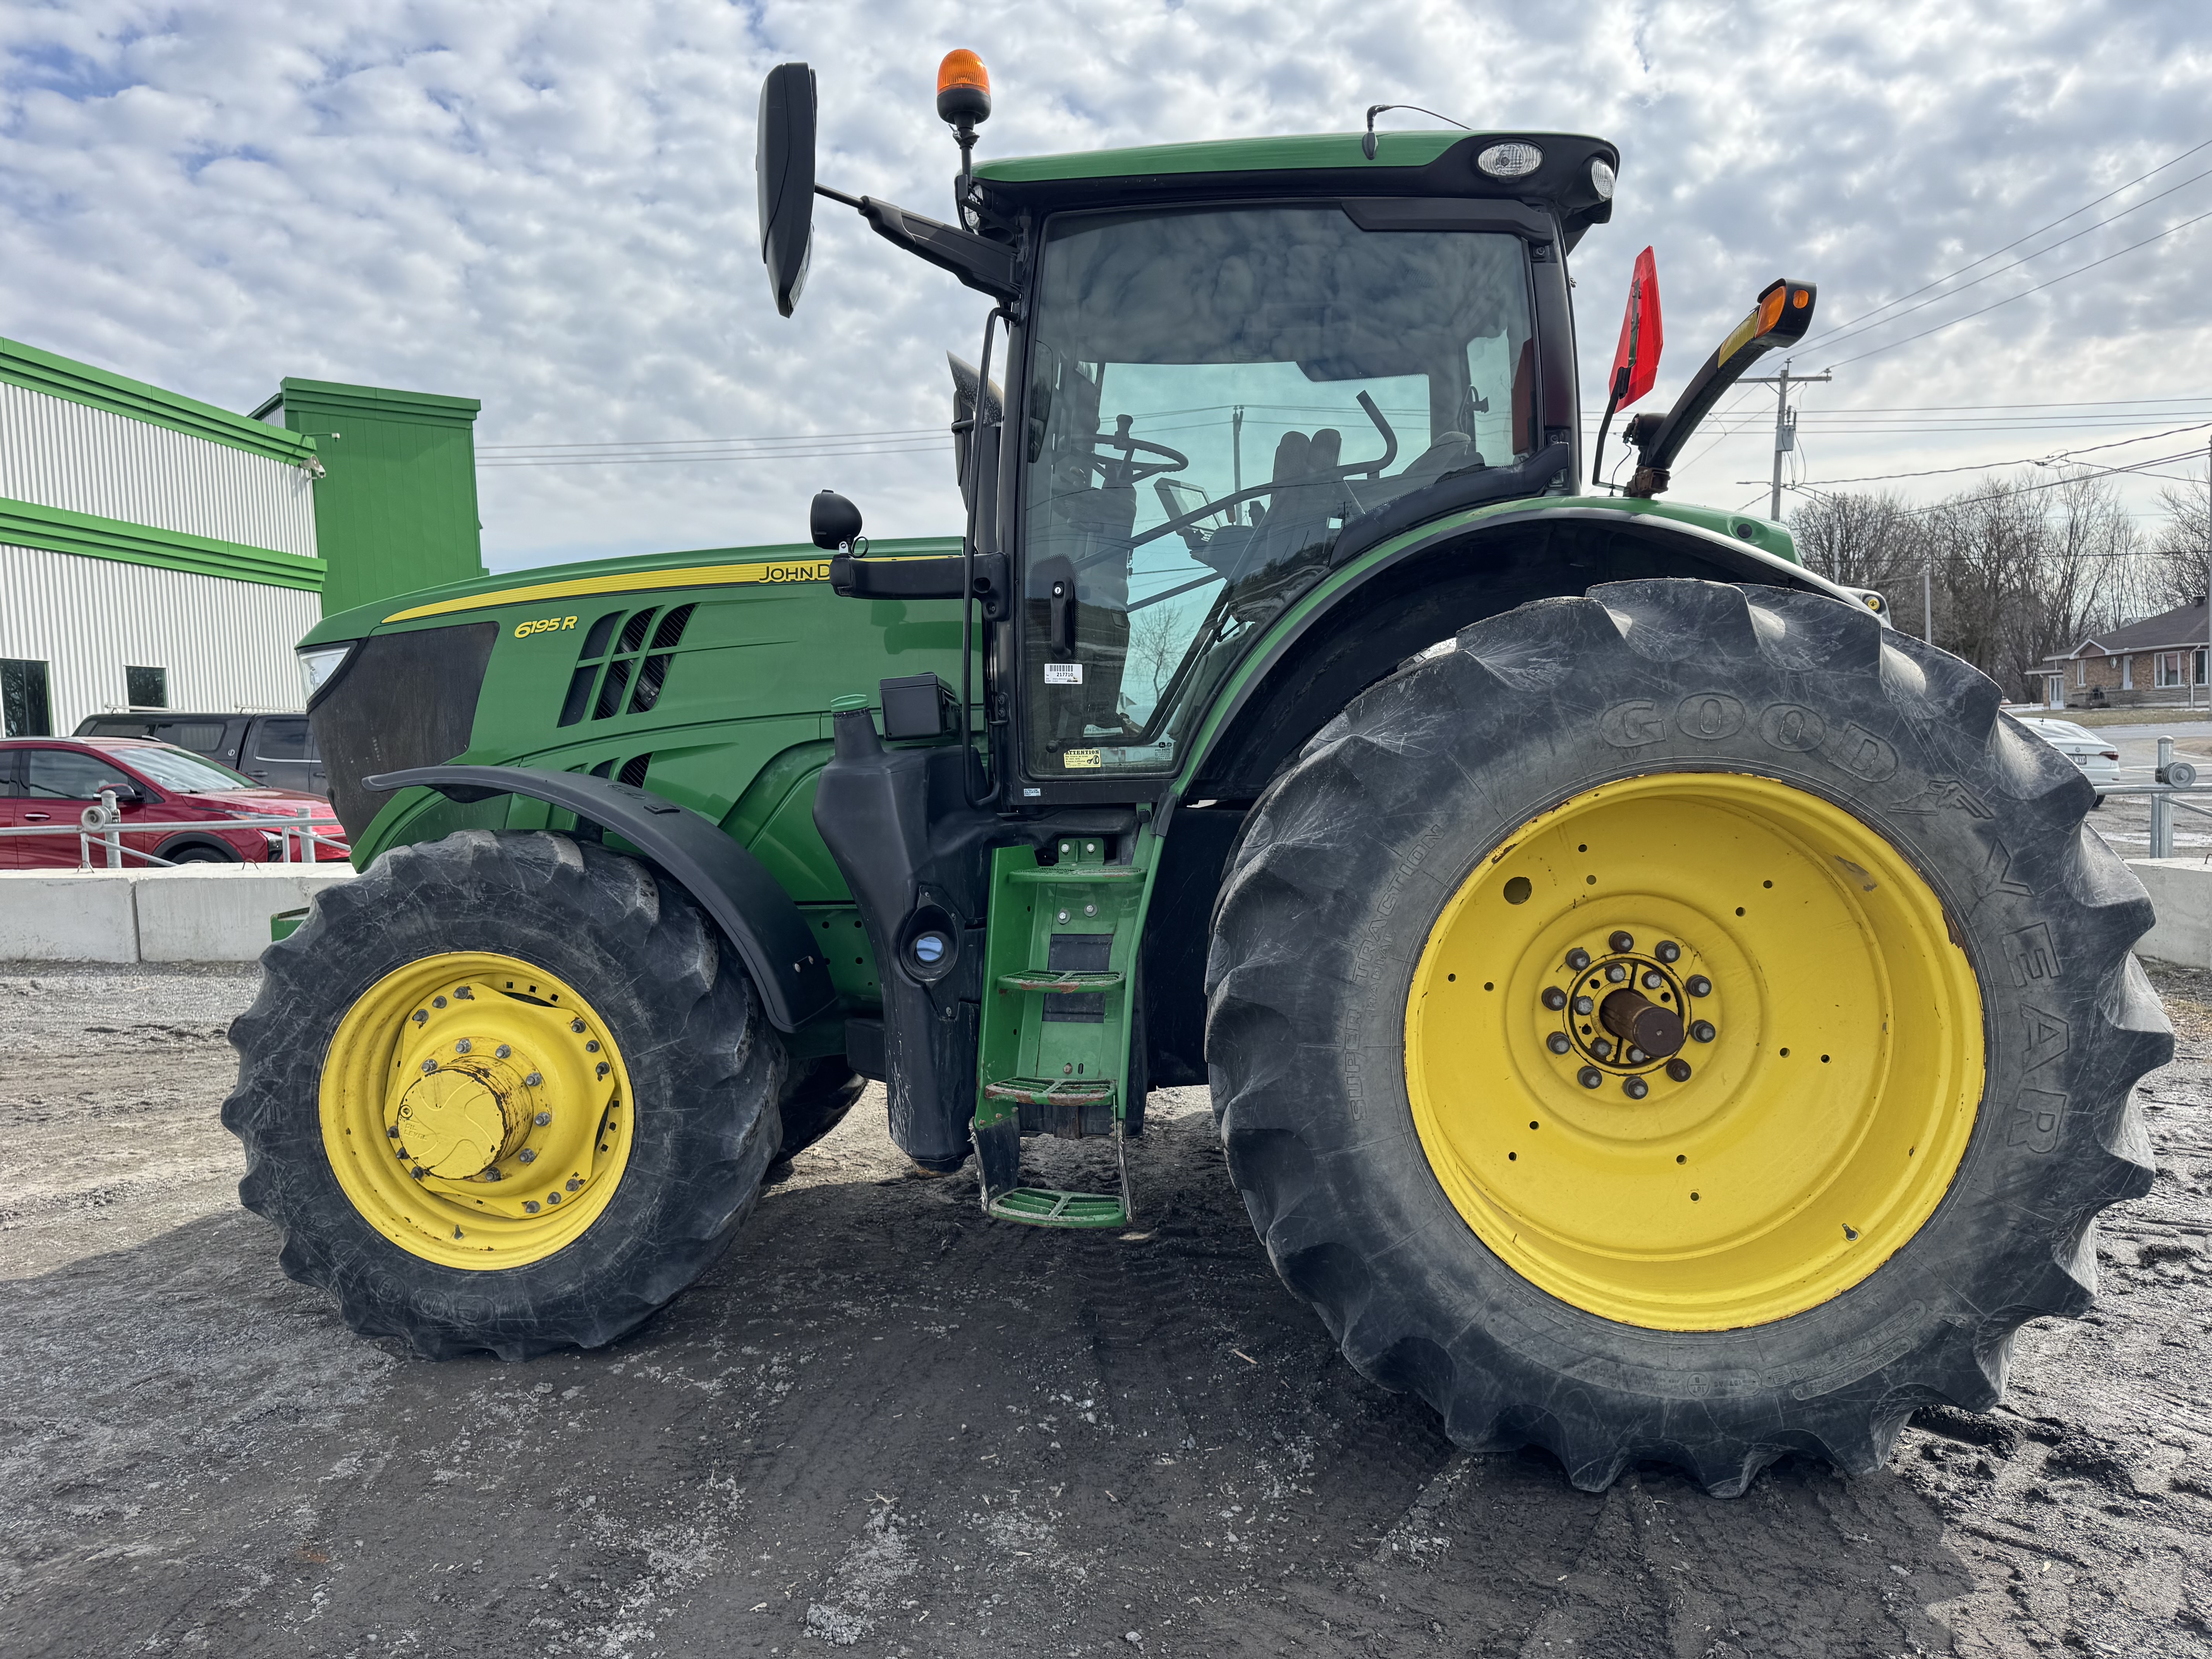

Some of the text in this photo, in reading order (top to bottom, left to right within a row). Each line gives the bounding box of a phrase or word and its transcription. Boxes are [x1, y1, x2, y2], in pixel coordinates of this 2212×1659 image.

[759, 566, 813, 581] JOHN
[1343, 823, 1448, 1121] SUPER TRACTION
[1366, 931, 1396, 1012] RADIAL
[404, 1130, 427, 1140] LEVEL
[405, 1123, 417, 1131] OIL
[1810, 1350, 1897, 1395] TUBELESS
